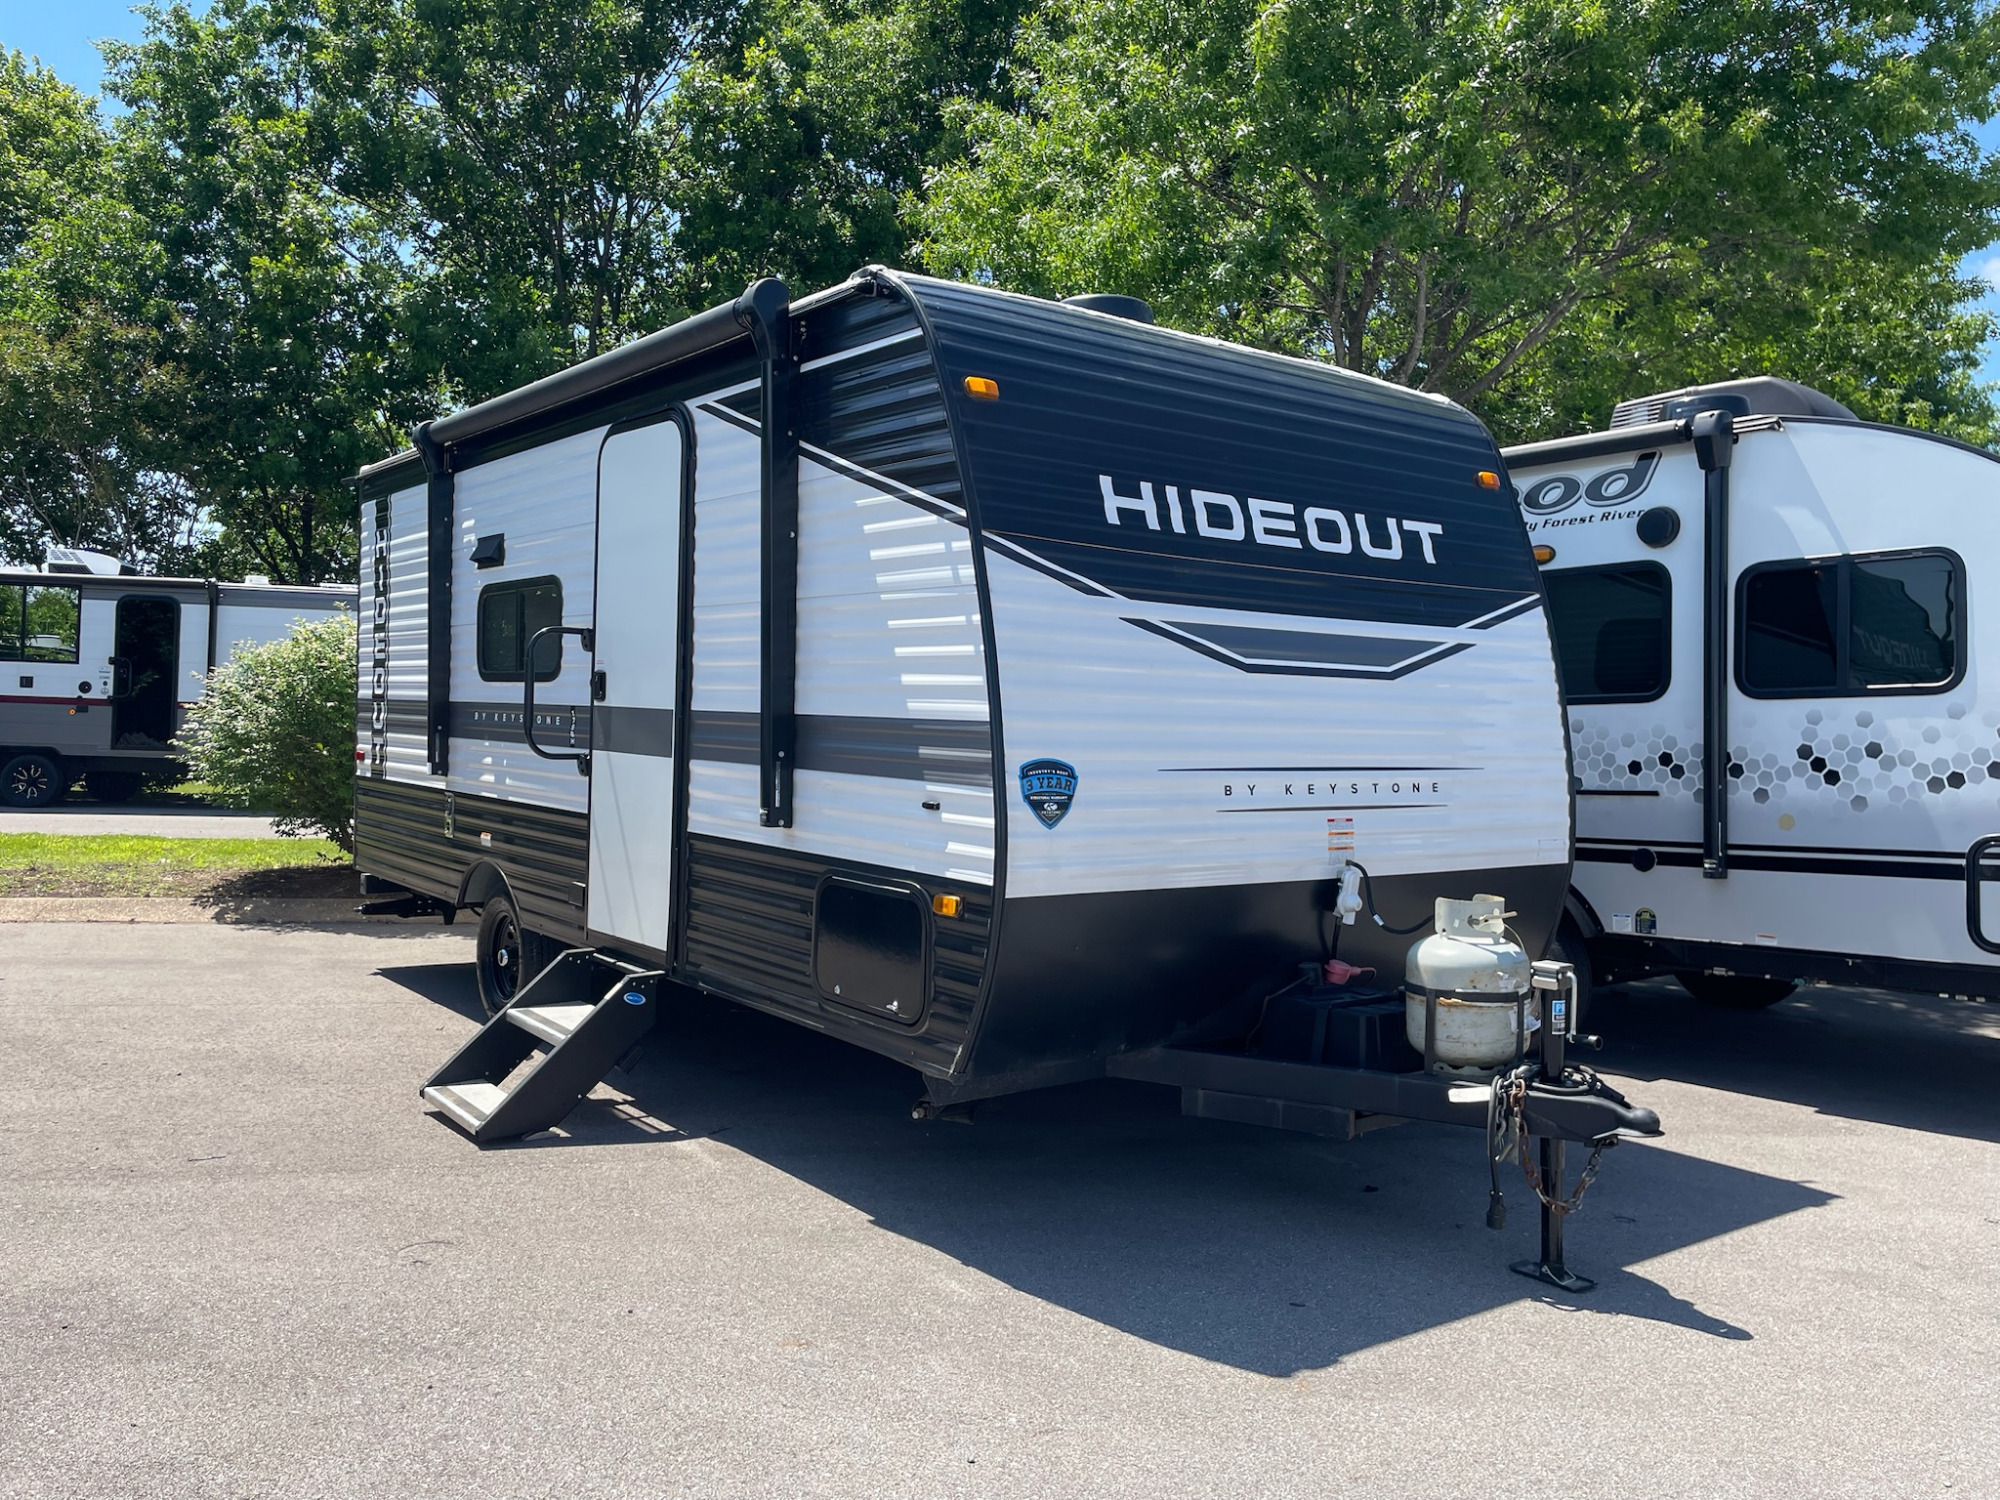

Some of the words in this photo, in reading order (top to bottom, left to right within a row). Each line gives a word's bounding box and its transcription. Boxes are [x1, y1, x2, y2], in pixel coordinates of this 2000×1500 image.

[1099, 474, 1443, 565] HIDEOUT
[1542, 514, 1596, 529] Forest
[1600, 509, 1645, 522] River
[373, 528, 388, 766] HIDEOUT
[474, 711, 487, 721] BY
[494, 713, 560, 725] KEYSONE
[1026, 779, 1034, 792] 3
[1037, 776, 1073, 791] YEAR
[1224, 784, 1256, 796] BY
[1285, 782, 1438, 795] KEYSTONE
